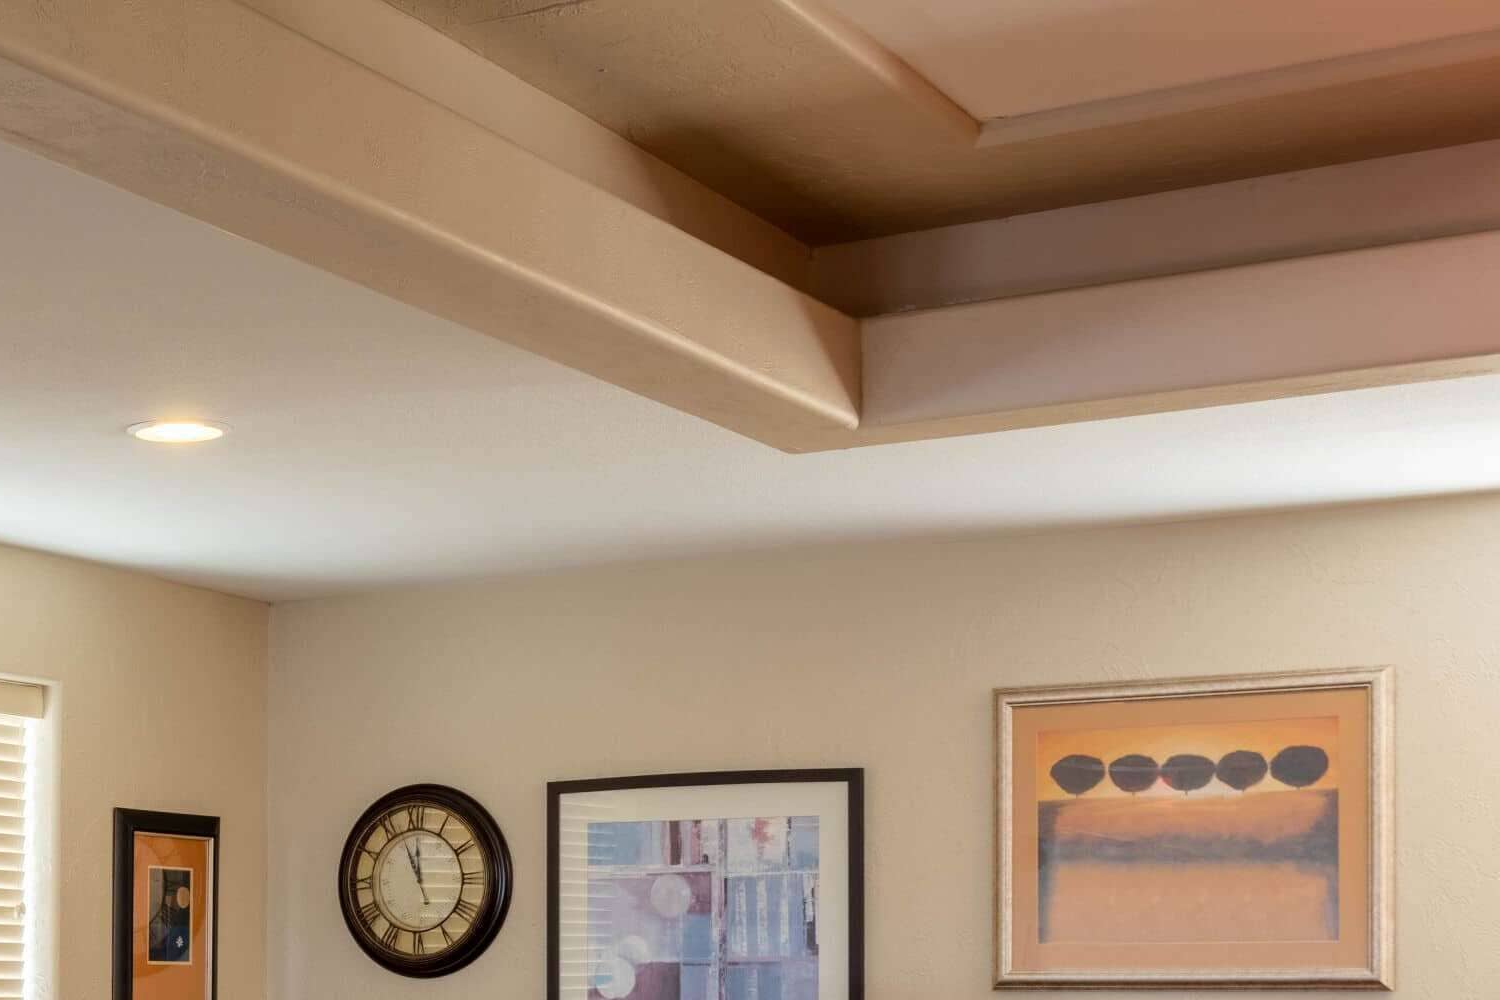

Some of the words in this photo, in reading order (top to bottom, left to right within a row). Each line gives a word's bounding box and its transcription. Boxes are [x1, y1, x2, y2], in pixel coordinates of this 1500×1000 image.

[407, 805, 425, 831] XII
[439, 814, 450, 836] I
[454, 839, 475, 857] II
[461, 870, 485, 886] III
[454, 898, 478, 924] IIII
[380, 923, 400, 951] VII
[412, 931, 426, 956] VI
[440, 924, 456, 947] V
